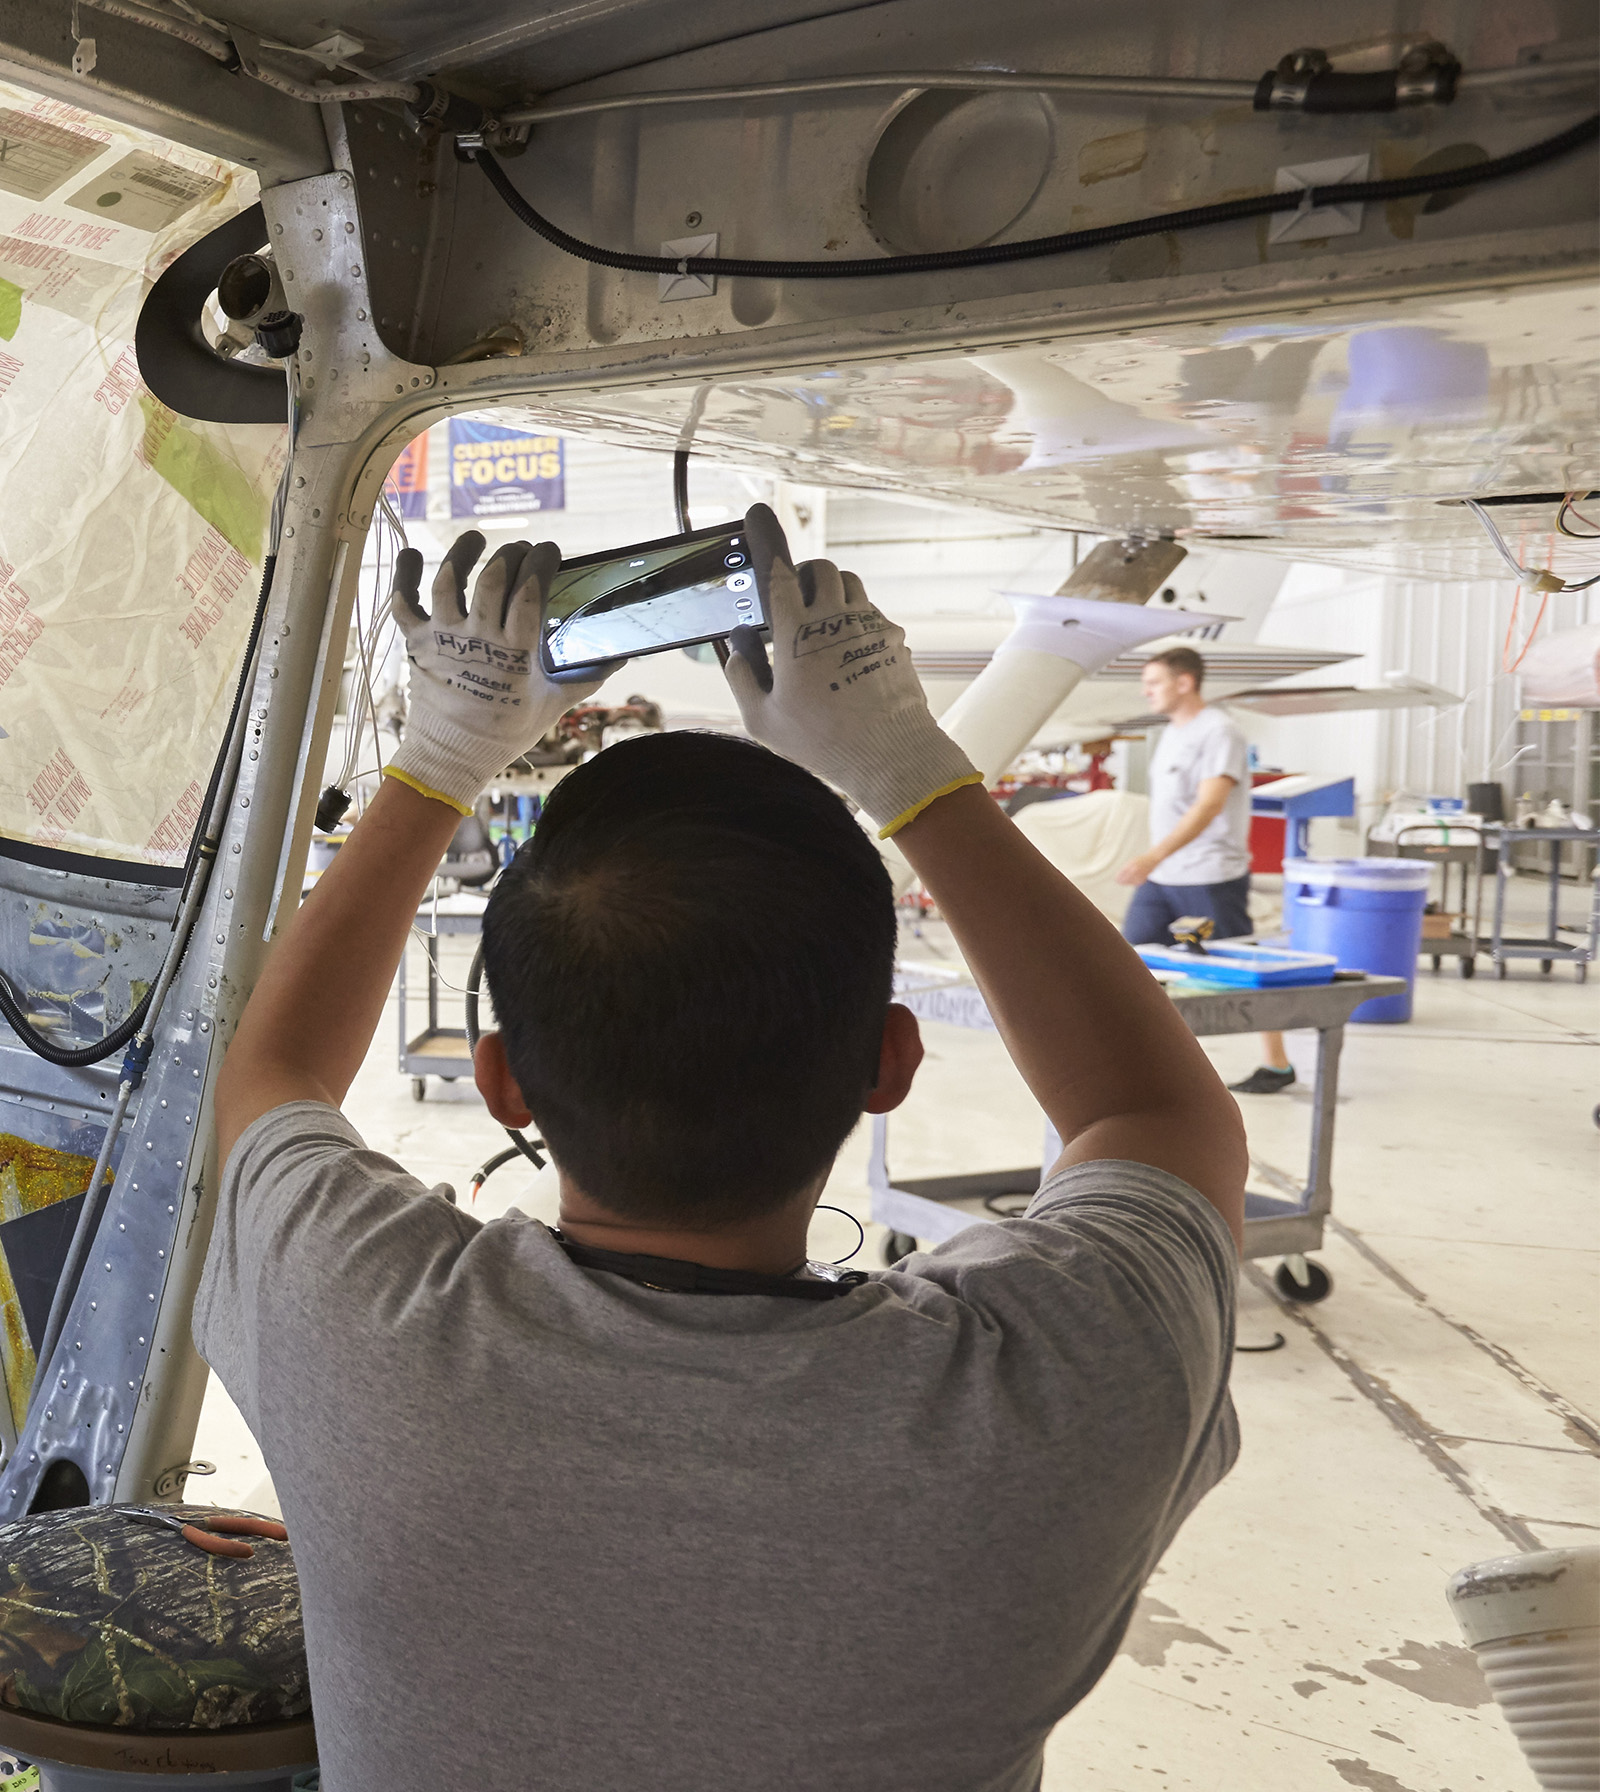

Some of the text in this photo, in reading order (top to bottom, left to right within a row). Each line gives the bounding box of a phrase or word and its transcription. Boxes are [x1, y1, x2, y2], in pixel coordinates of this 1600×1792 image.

[453, 436, 560, 461] CUSTOMER
[453, 452, 561, 487] FOCUS
[439, 634, 527, 664] HyFlex
[843, 638, 886, 662] Ansell
[487, 656, 528, 673] Foam
[461, 670, 512, 691] Ansell
